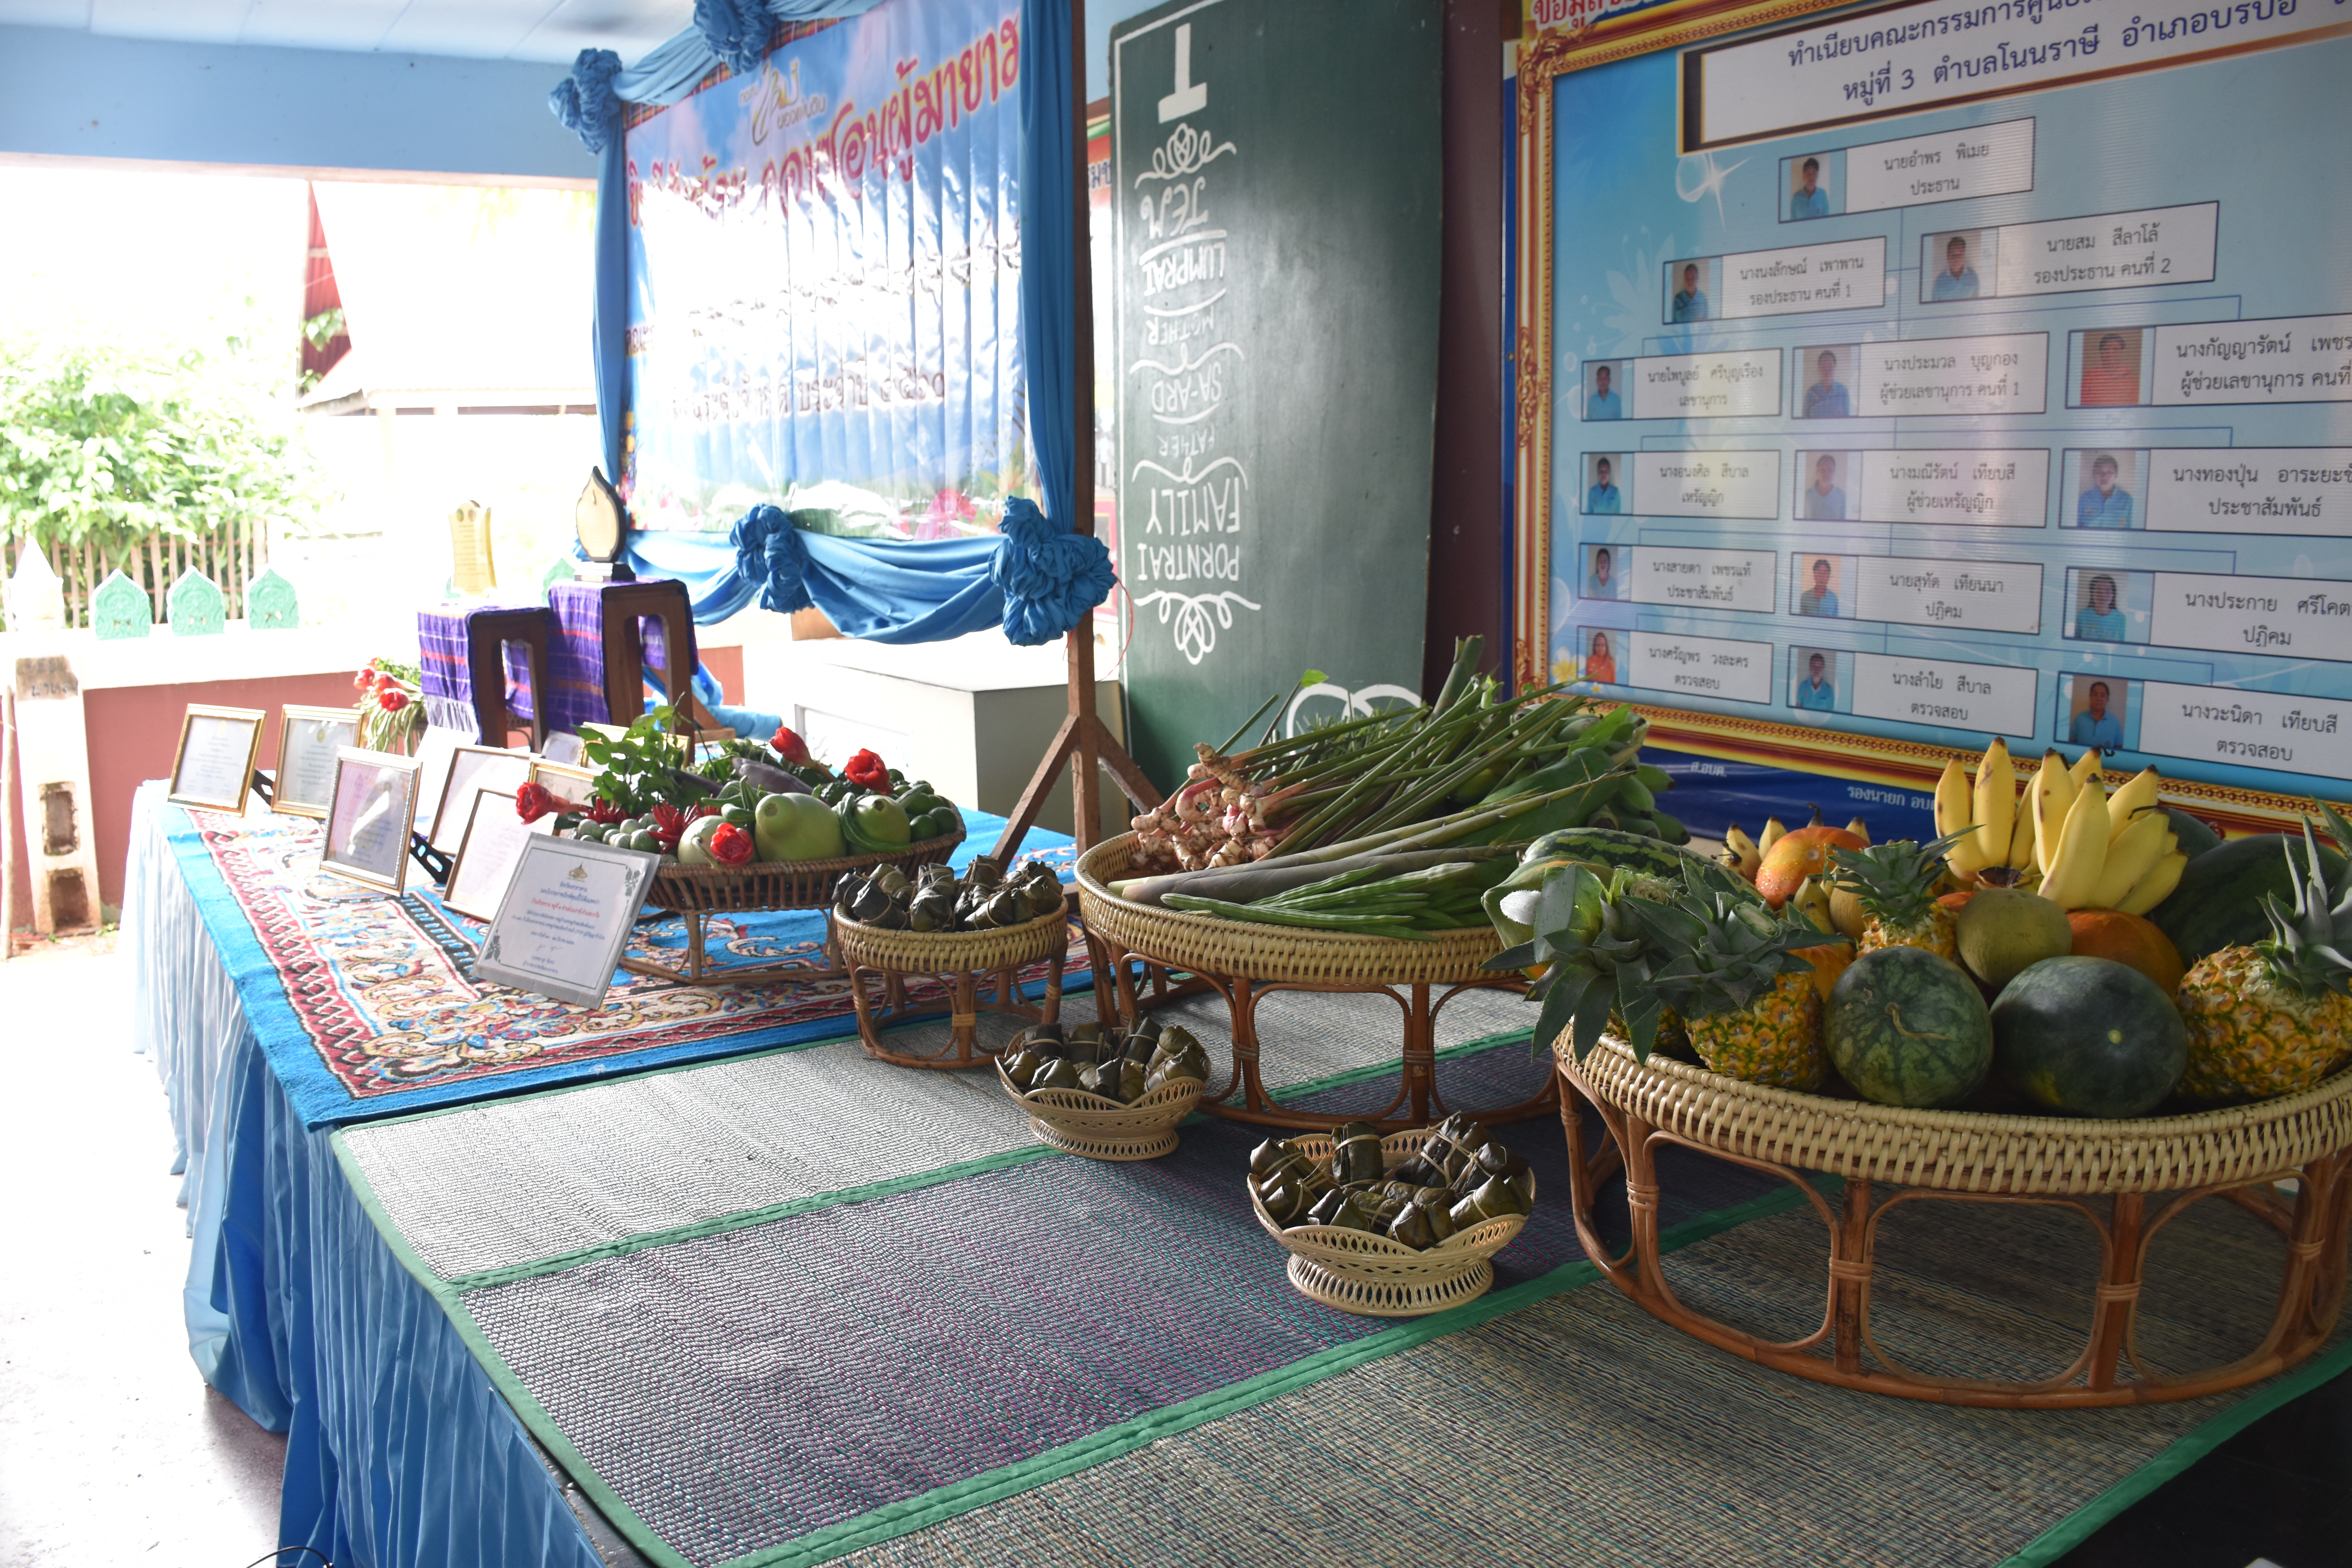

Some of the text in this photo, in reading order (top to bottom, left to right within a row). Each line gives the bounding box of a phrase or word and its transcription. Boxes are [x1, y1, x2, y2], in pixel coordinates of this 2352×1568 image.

[1844, 61, 1891, 106] หมู่ที่
[1901, 69, 1914, 90] 3
[1934, 24, 2100, 83] ตำบลโนนราษี
[1911, 178, 1960, 195] ประธาน
[2047, 236, 2096, 252] นายสม
[2034, 251, 2171, 284] รองประธาน คนที่ 2
[1749, 289, 1811, 306] รองประธาน
[1846, 284, 1851, 298] 1
[2176, 332, 2292, 360] นางกัญญารัตน์
[1884, 355, 1956, 371] นางประมวล
[2181, 359, 2351, 397] ผู้ช่วยเลขานุการ คนที่
[2013, 382, 2019, 396] 1
[1146, 477, 1240, 536] FAMILY
[2209, 496, 2323, 517] ประชาสัมพันธ์
[1137, 543, 1240, 581] PORNTRAI
[2185, 591, 2278, 612] นางประกาย
[2243, 624, 2292, 647] ปฏิคม
[1911, 702, 1969, 720] ตรวจสอบ
[2182, 704, 2338, 733] นางวะนิดา เทียบสี
[2217, 740, 2293, 761] ตรวจสอบ
[1847, 786, 1906, 806] รองนายก
